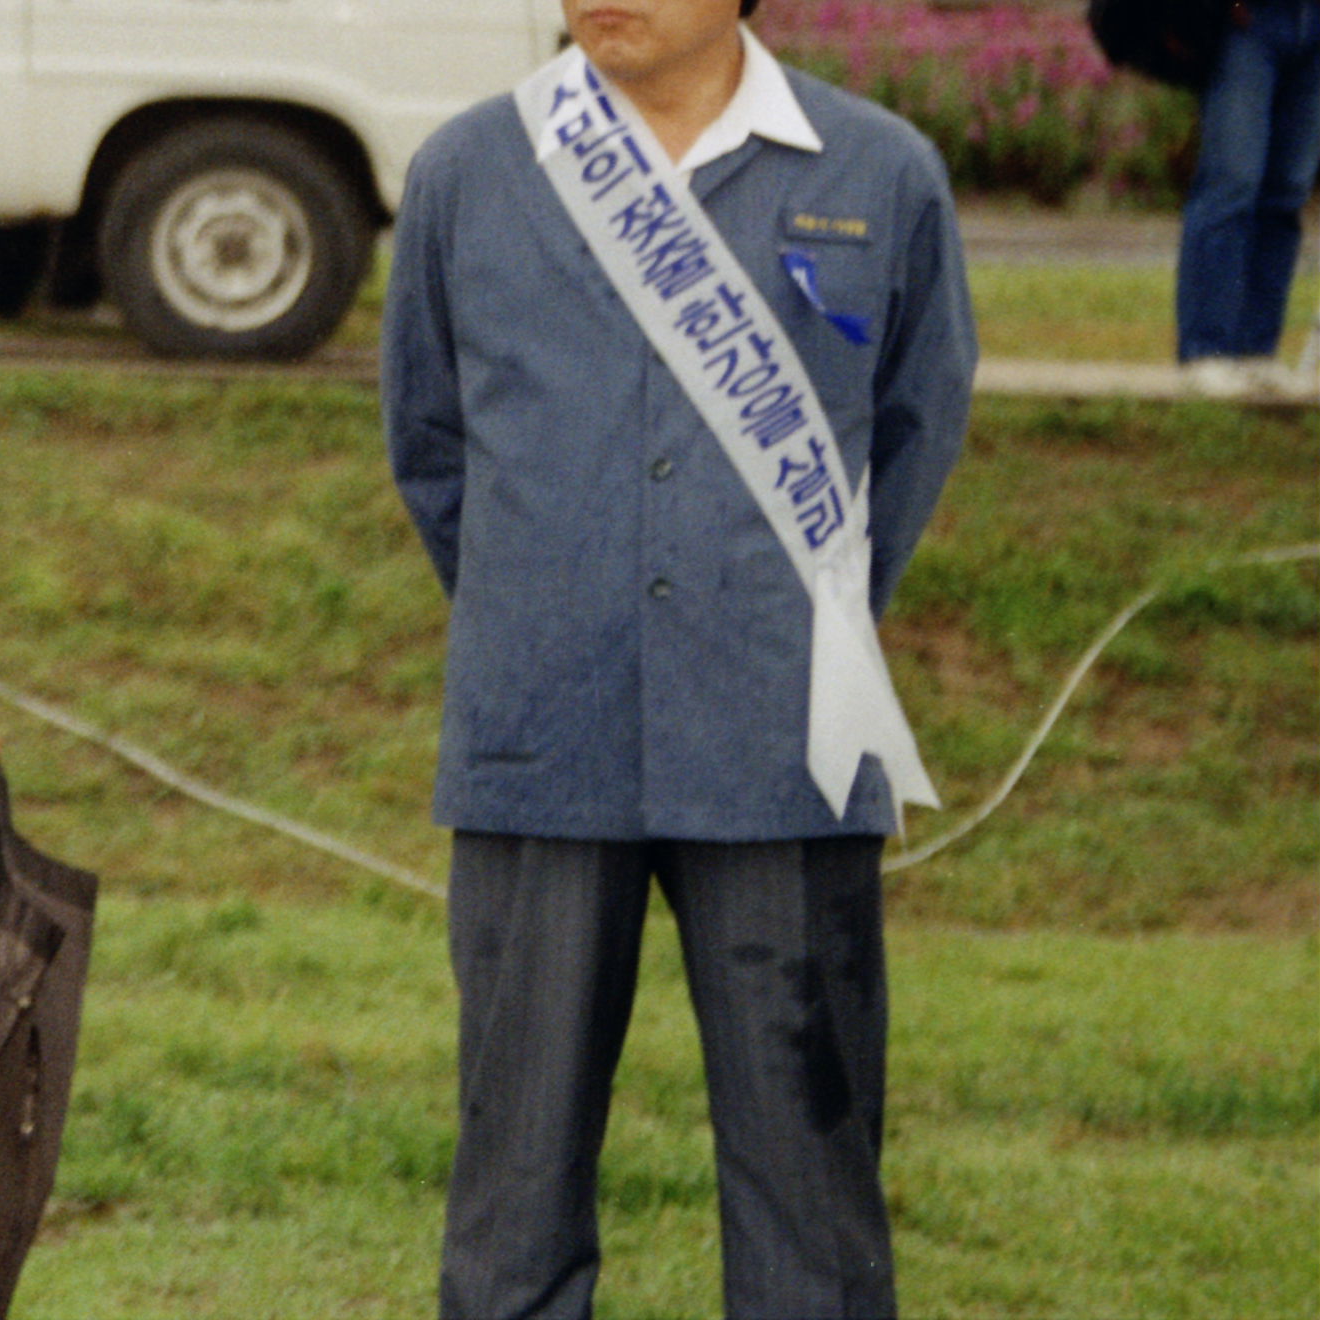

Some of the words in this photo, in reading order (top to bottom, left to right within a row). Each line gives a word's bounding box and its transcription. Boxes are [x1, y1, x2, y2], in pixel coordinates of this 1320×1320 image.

[549, 62, 651, 202] 시민의
[610, 183, 717, 301] 젖줄
[674, 283, 808, 449] 한강을
